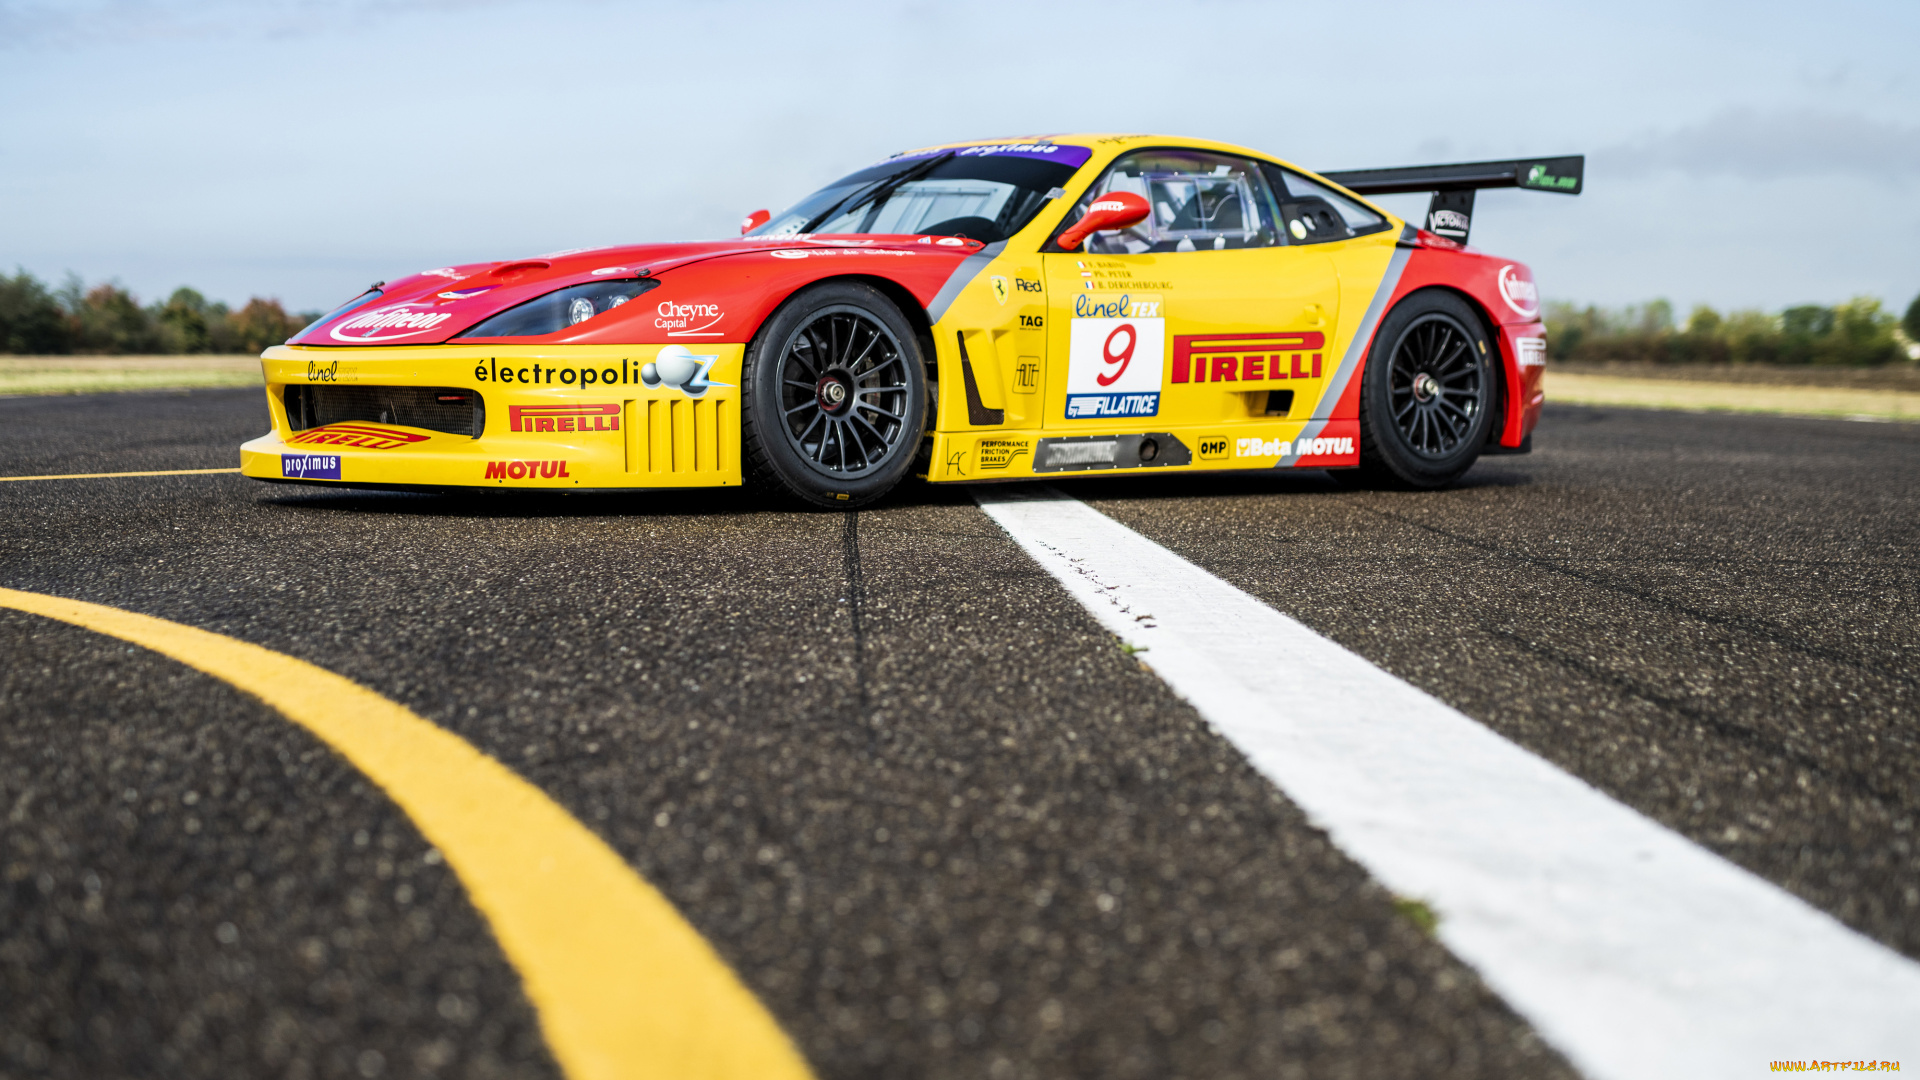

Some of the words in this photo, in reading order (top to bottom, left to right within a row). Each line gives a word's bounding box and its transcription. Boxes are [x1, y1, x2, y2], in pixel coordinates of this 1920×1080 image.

[1015, 278, 1042, 292] Red
[657, 301, 719, 321] Cheyne
[1019, 315, 1043, 327] TAG
[654, 317, 687, 331] Capital
[1097, 323, 1137, 387] 9
[1171, 331, 1325, 384] PIRELLI
[475, 357, 640, 390] électropoli
[1095, 395, 1157, 415] FILLATTICE
[508, 404, 621, 432] PIRELLI
[281, 425, 432, 450] PIRELLI
[1201, 441, 1227, 454] OMP
[1250, 438, 1292, 456] Beta
[1295, 437, 1355, 456] MOTUL
[285, 455, 336, 478] proximus
[485, 460, 570, 479] MOTUL
